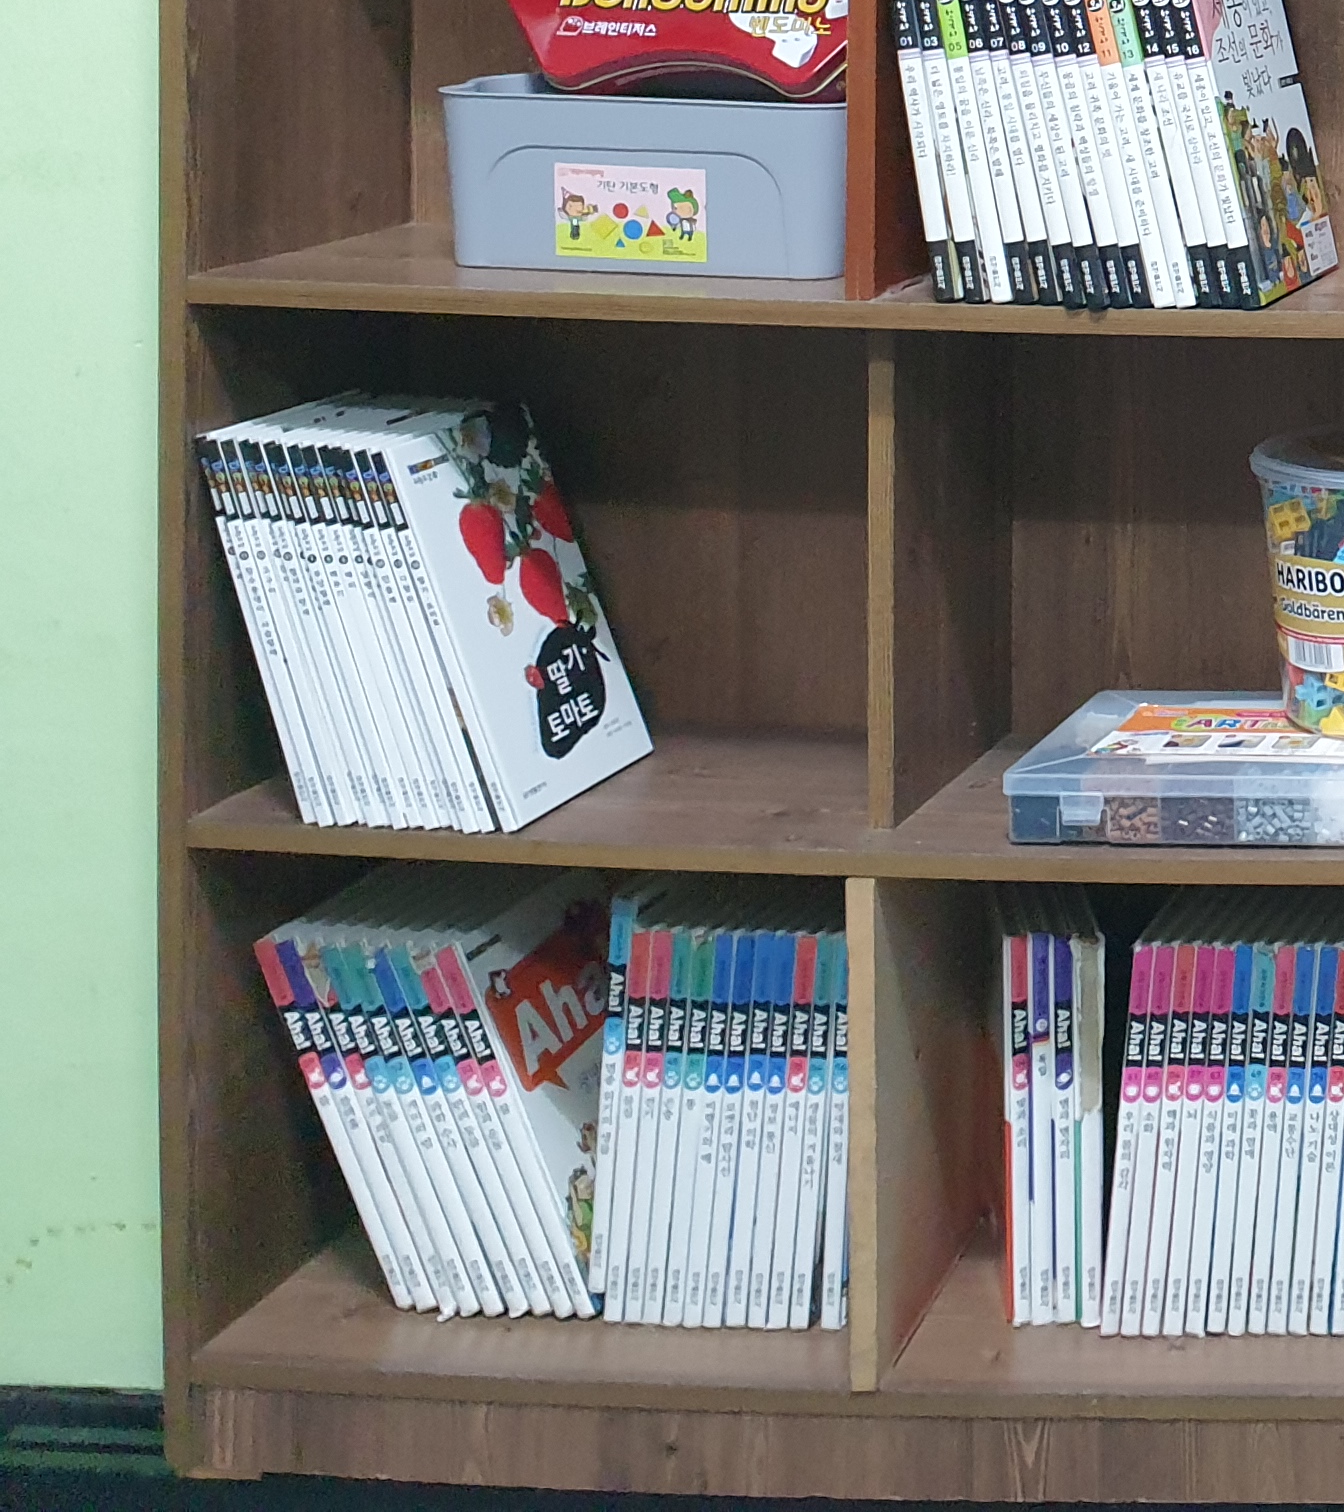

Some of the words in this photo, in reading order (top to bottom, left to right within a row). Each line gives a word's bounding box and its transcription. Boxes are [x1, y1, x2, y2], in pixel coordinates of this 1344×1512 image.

[582, 20, 658, 37] 브레인티저스
[900, 36, 913, 46] 01
[923, 36, 938, 47] 03
[969, 38, 983, 48] 06
[990, 37, 1004, 48] 07
[1011, 40, 1026, 51] 08
[1216, 31, 1249, 64] 조선의
[1247, 18, 1285, 60] 문화가
[949, 42, 963, 52] 05
[1031, 42, 1046, 52] 09
[1056, 43, 1069, 53] 10
[1078, 42, 1090, 53] 12
[1101, 49, 1112, 58] 11
[1123, 48, 1135, 59] 13
[1146, 43, 1159, 54] 14
[1166, 43, 1180, 55] 15
[1187, 44, 1200, 56] 16
[1241, 64, 1273, 100] 빛났다
[546, 692, 600, 743] 토마토
[609, 972, 624, 1012] Aha!
[284, 1011, 311, 1050] Aha!
[348, 1015, 375, 1054] Aha!
[395, 1018, 422, 1056] Aha!
[464, 1020, 491, 1057] Aha!
[649, 1006, 664, 1046] Aha!
[710, 1010, 726, 1049] Aha!
[752, 1009, 768, 1049] Aha!
[792, 1010, 808, 1050] Aha!
[1013, 1009, 1028, 1049] Aha!
[1128, 1021, 1145, 1061] Aha!
[1170, 1019, 1186, 1059] Aha!
[1271, 1021, 1288, 1061] Aha!
[1292, 1022, 1307, 1062] Aha!
